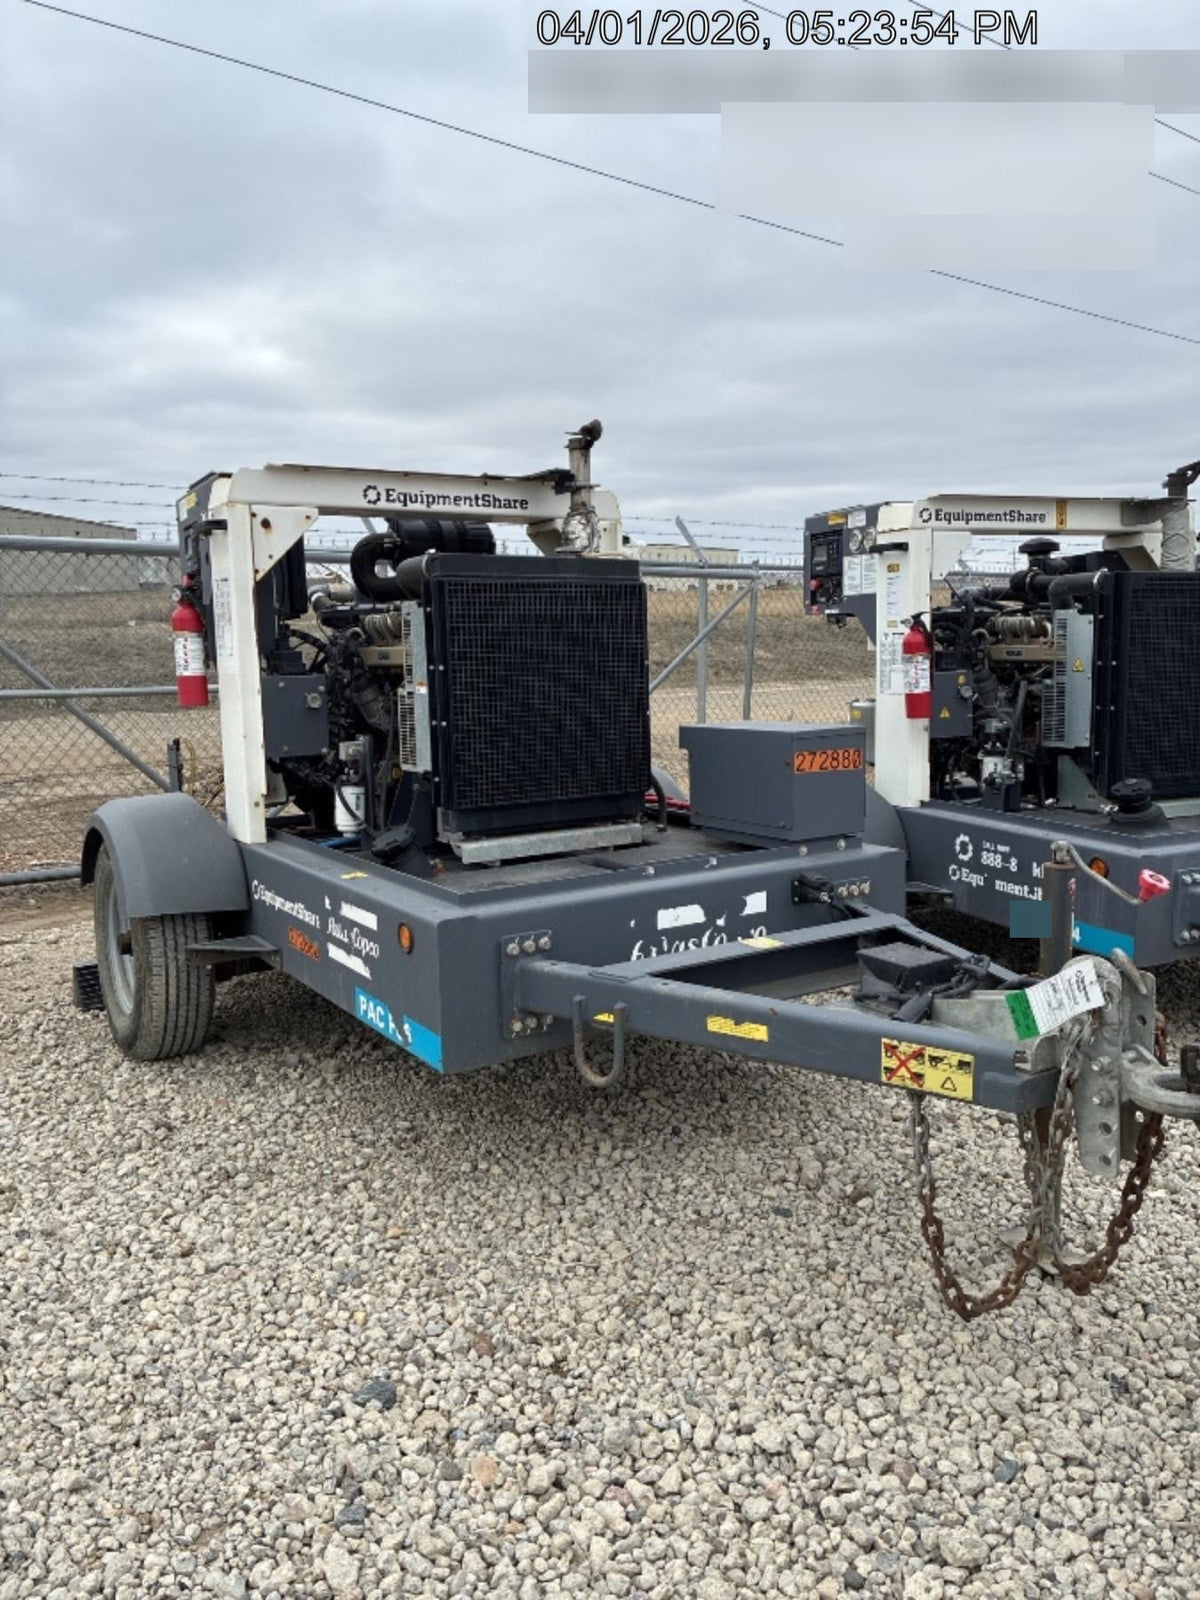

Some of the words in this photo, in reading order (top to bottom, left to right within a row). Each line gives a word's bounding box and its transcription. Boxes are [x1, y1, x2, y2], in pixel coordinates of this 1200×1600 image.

[384, 487, 529, 511] EquipmentShare
[934, 508, 1048, 525] EquipmentShare
[359, 993, 385, 1028] PAC
